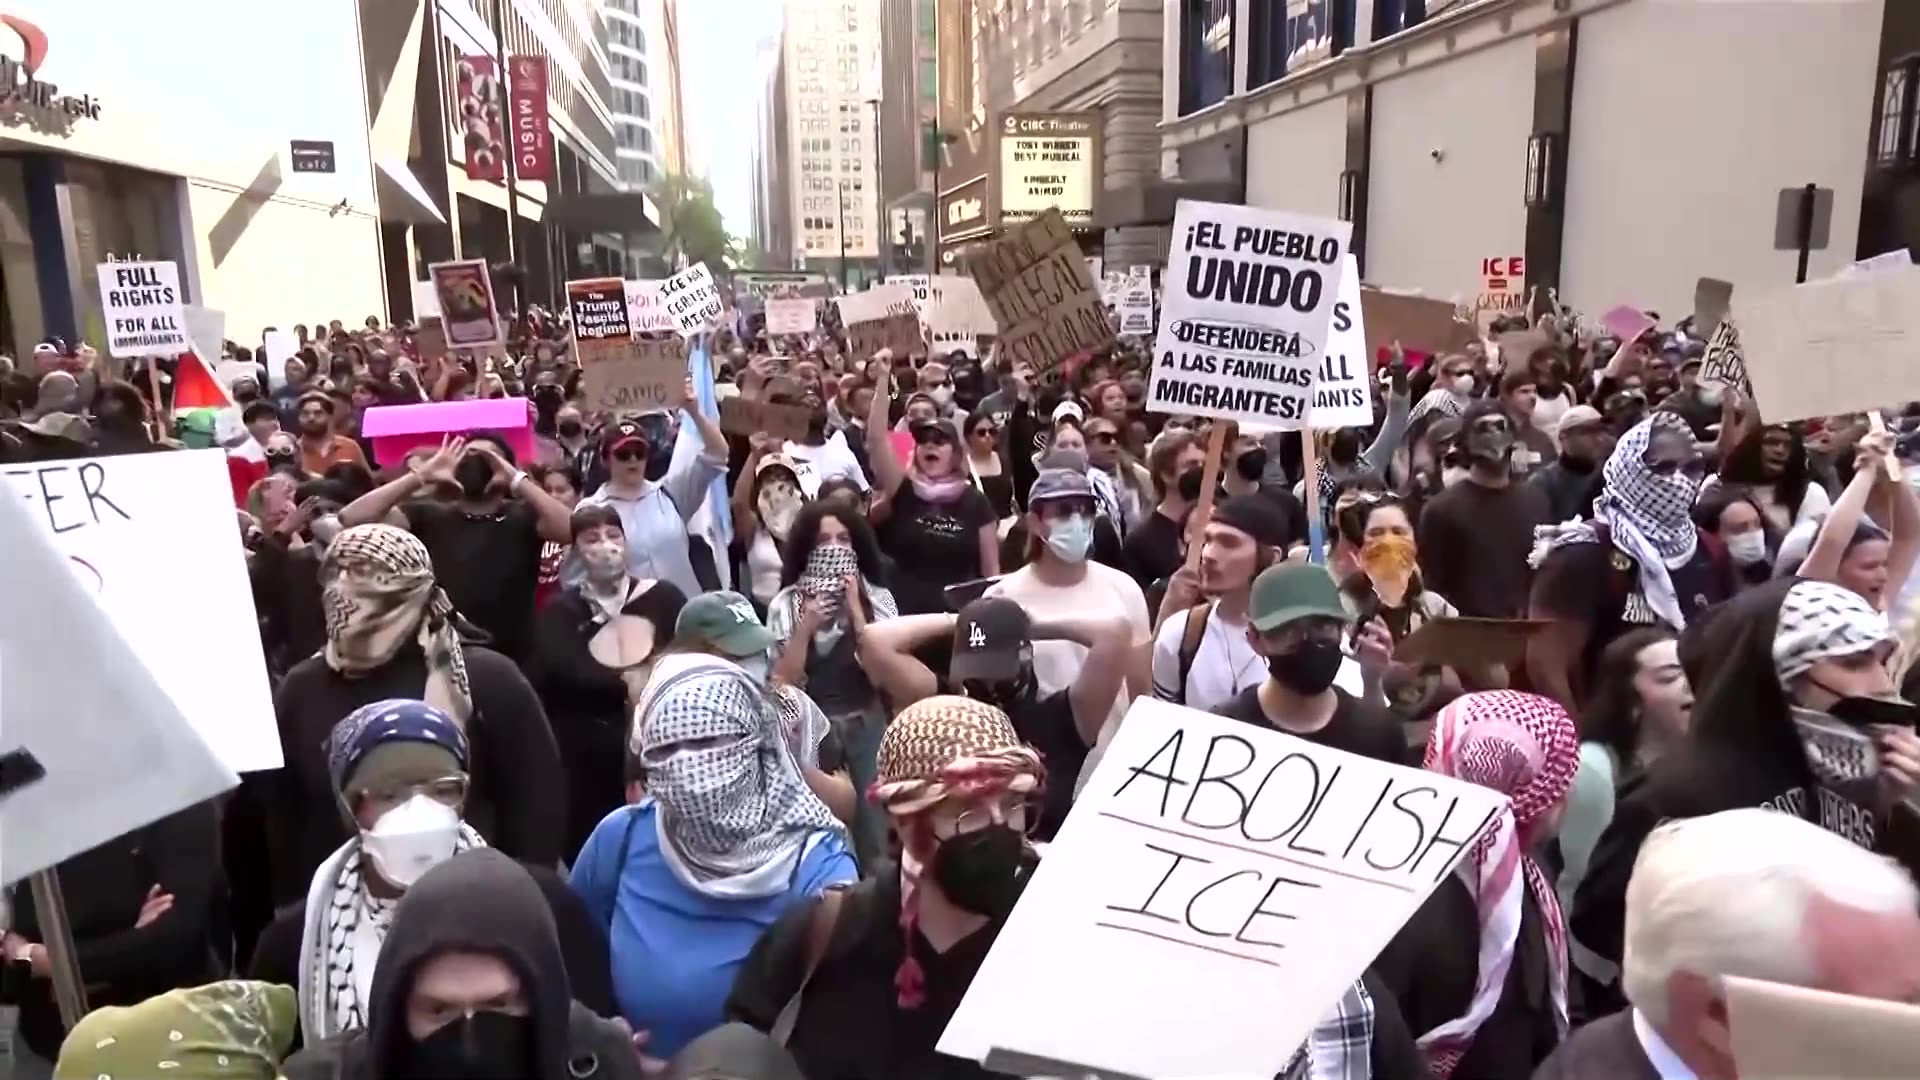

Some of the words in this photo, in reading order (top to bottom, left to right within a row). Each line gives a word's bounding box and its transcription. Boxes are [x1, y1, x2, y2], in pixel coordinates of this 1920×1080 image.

[519, 99, 537, 167] MUSIC
[1234, 226, 1339, 265] PUEBLO
[116, 267, 162, 287] FULL
[1483, 256, 1523, 276] ICE
[109, 287, 174, 307] RIGHTS
[1186, 255, 1322, 313] UNIDO
[576, 301, 620, 312] Trump
[577, 311, 624, 324] Fascist
[115, 318, 146, 333] FOR
[151, 316, 178, 331] ALL
[578, 324, 627, 337] Regime
[114, 333, 184, 348] IMMIGRANTS
[1177, 320, 1301, 358] DEFENDERÁ
[1161, 351, 1174, 368] A
[1180, 353, 1217, 374] LAS
[1222, 357, 1312, 388] FAMILIAS
[1155, 378, 1306, 420] MIGRANTES!
[969, 621, 986, 647] LA
[1113, 728, 1498, 882] ABOLISH
[1107, 843, 1321, 948] ICE
